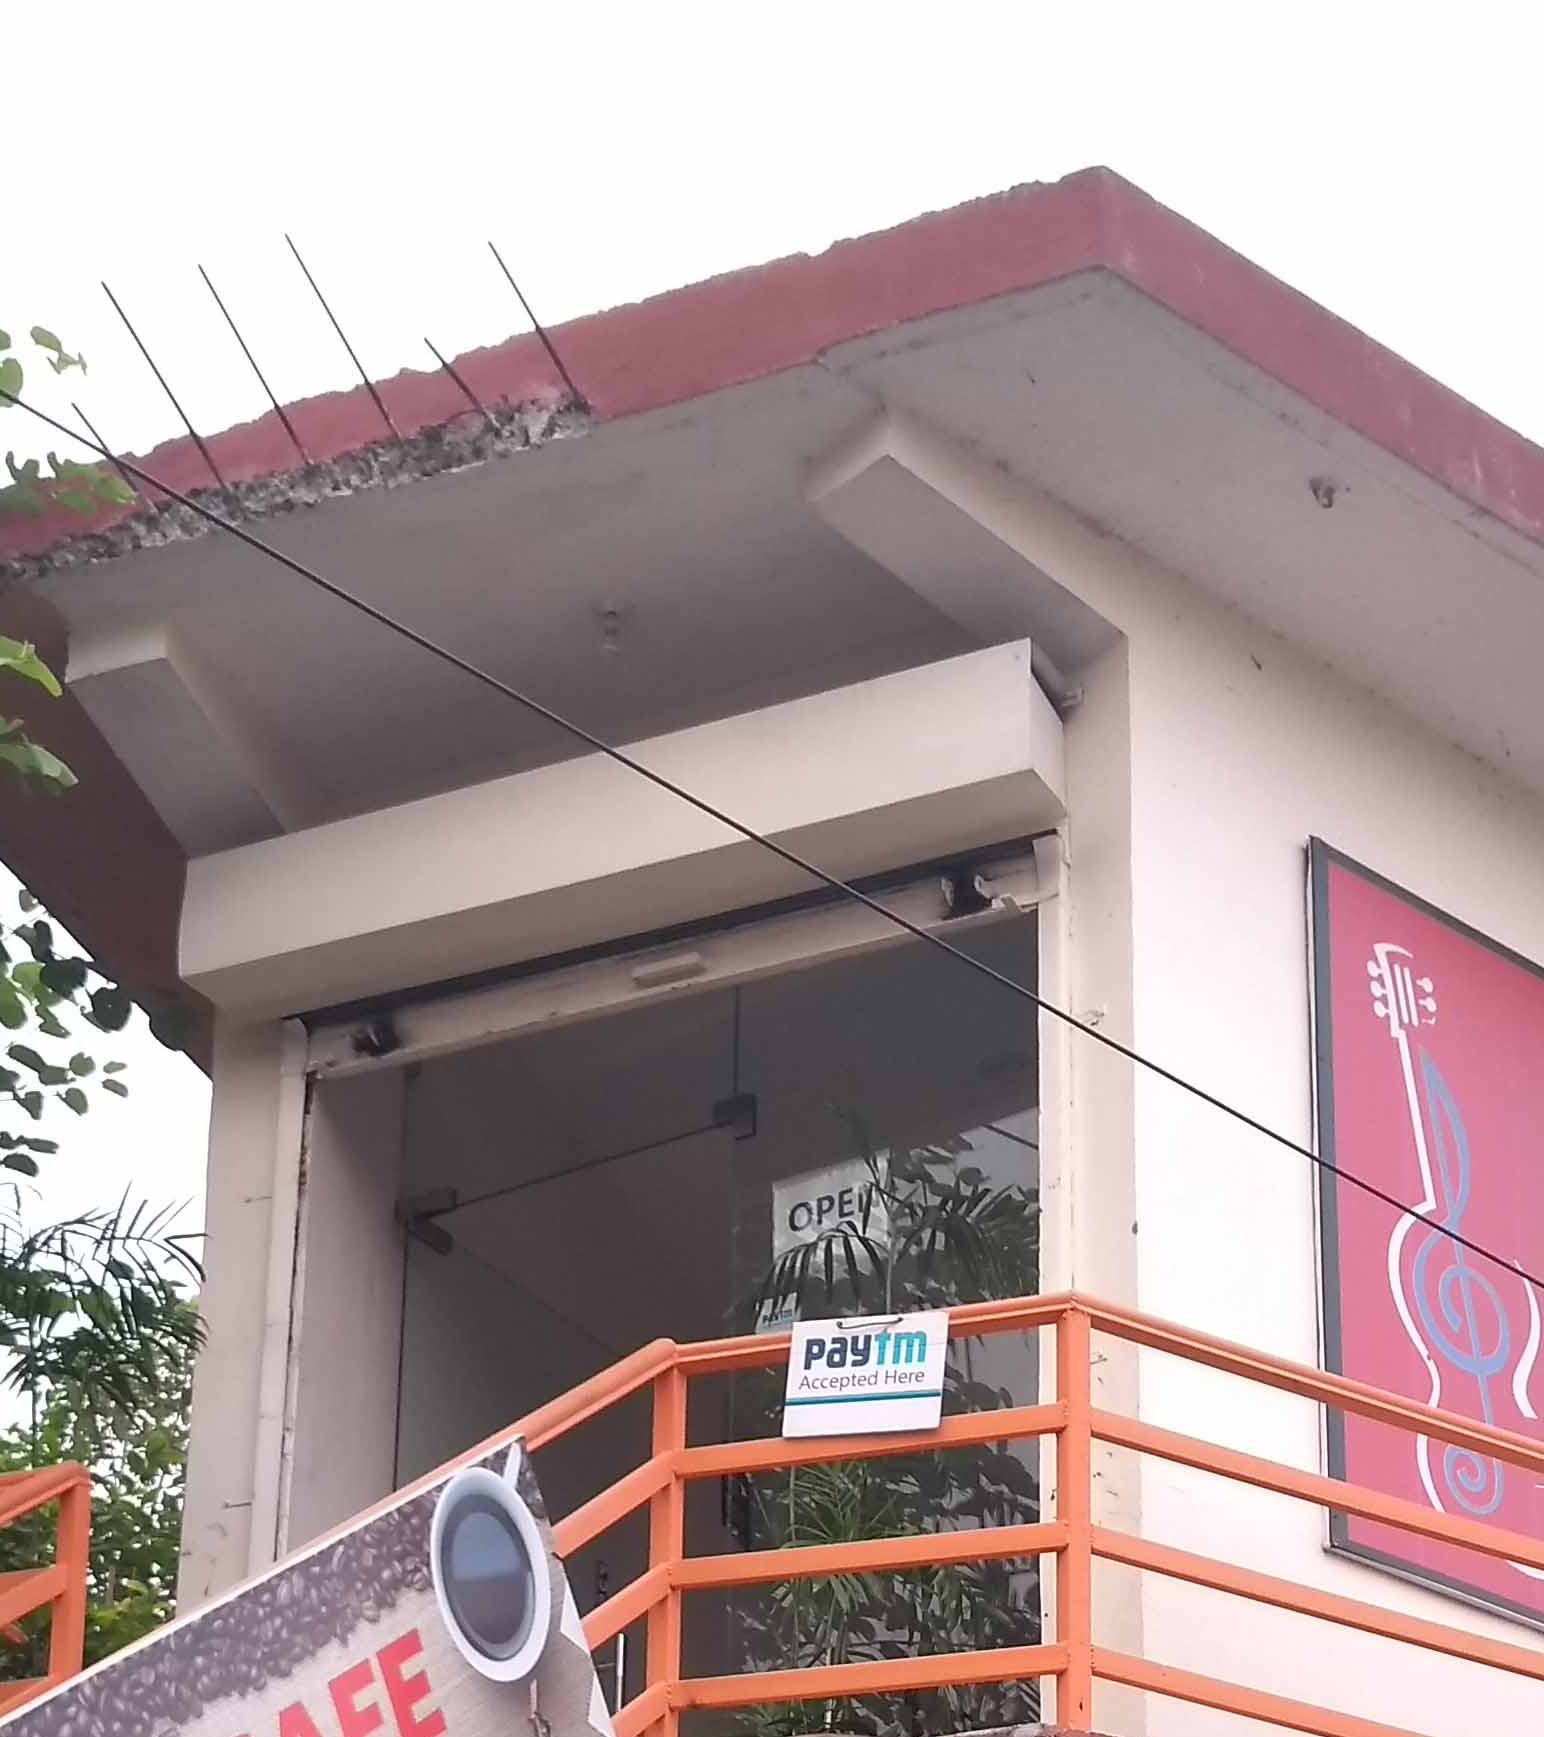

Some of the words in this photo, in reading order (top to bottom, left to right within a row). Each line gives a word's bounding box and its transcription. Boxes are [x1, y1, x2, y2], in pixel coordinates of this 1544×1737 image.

[789, 1184, 880, 1232] OPE
[798, 1371, 878, 1391] Accepted
[884, 1369, 925, 1385] Here
